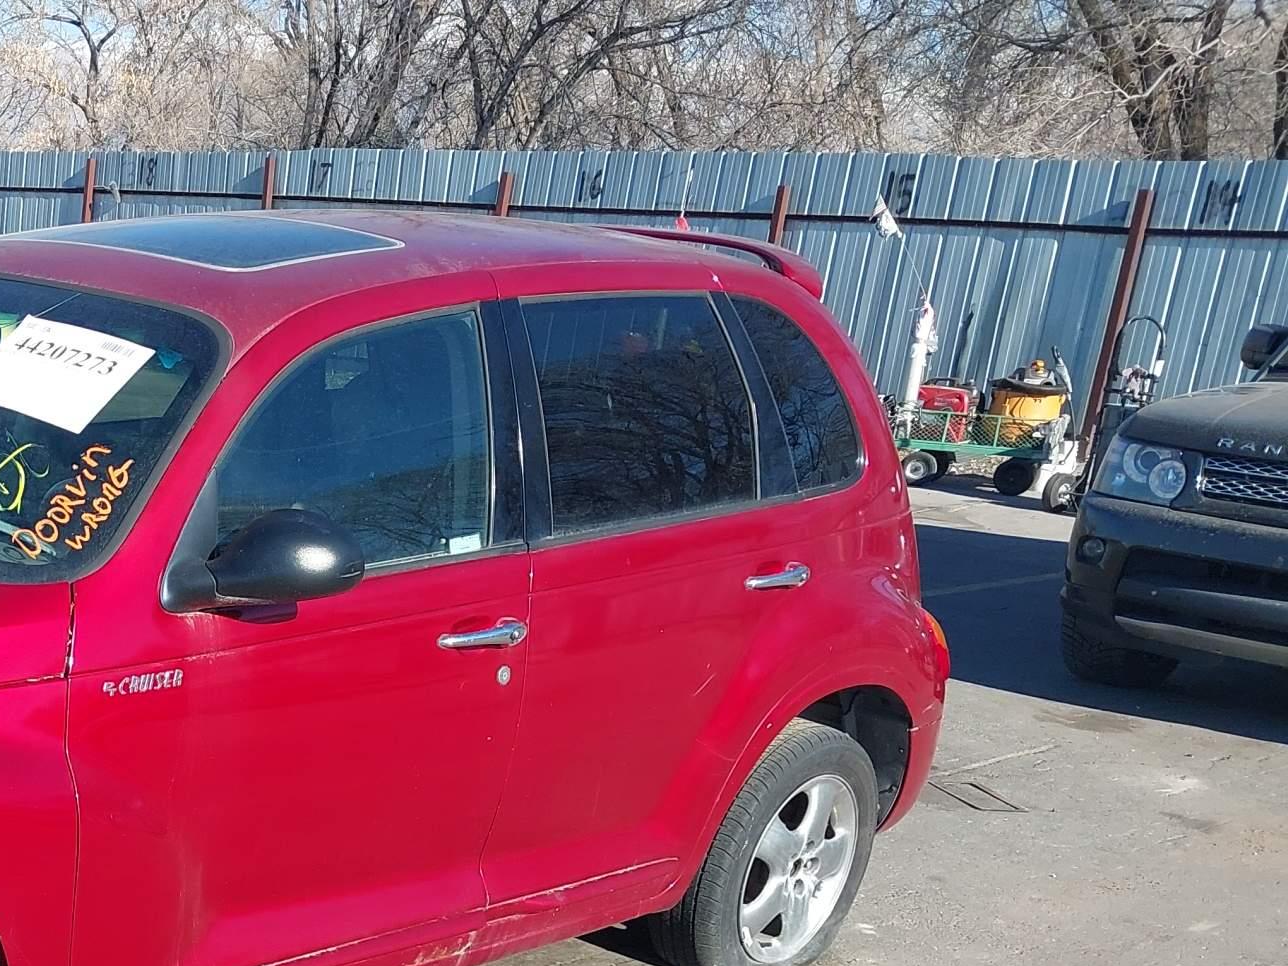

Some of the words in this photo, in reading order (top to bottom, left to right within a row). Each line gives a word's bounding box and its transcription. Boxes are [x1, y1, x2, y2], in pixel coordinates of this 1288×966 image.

[139, 156, 158, 187] 18
[310, 159, 333, 193] 17
[578, 168, 603, 203] 16
[15, 336, 118, 376] 44207273
[118, 668, 185, 696] CRUISER
